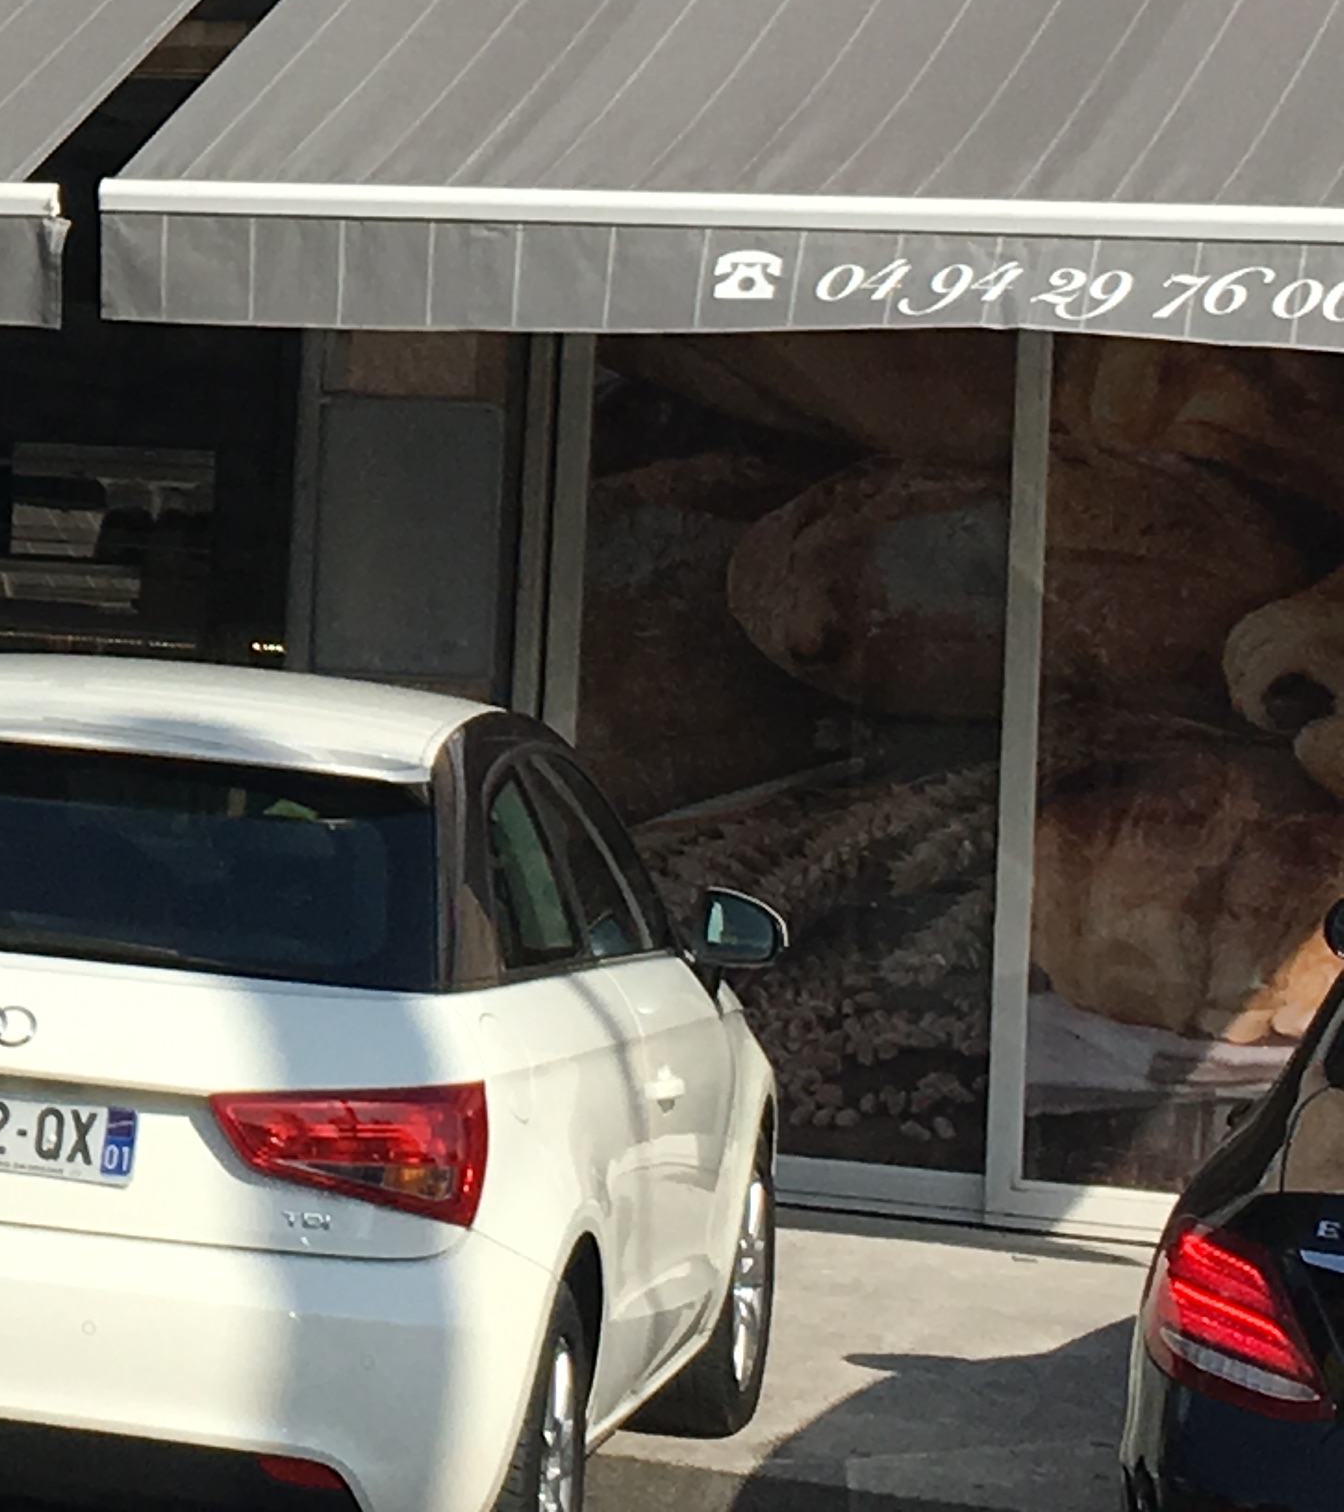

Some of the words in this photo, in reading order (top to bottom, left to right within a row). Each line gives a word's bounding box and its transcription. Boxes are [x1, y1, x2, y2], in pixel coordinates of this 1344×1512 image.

[815, 258, 912, 302] 04
[897, 260, 1025, 316] 94
[1029, 267, 1135, 321] 29
[1151, 265, 1277, 319] 76
[103, 1144, 131, 1171] 01
